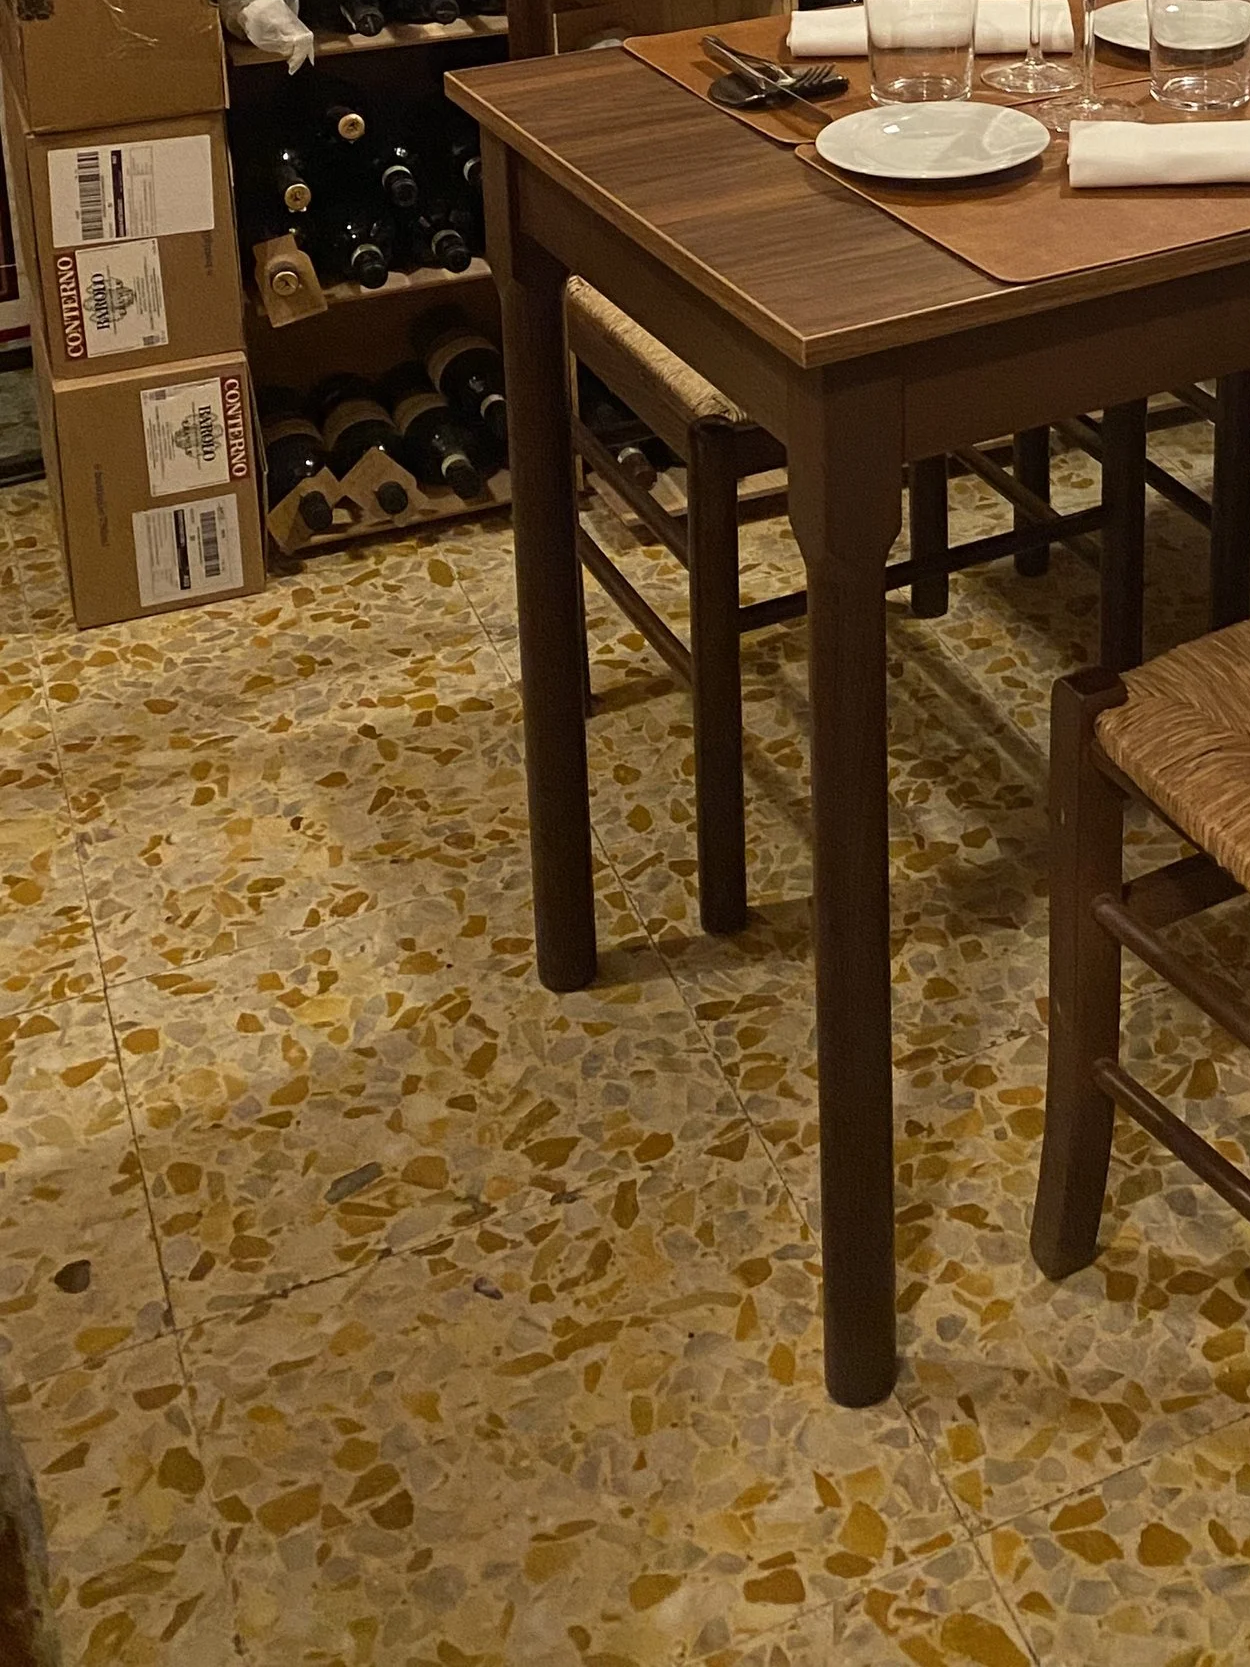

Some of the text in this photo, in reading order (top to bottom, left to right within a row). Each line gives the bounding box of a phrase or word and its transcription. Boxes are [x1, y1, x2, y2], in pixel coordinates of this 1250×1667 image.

[56, 256, 84, 358] CONTERNO
[91, 273, 110, 330] BAROLO
[198, 405, 216, 462] BAROLO
[224, 377, 248, 477] CONTERNO
